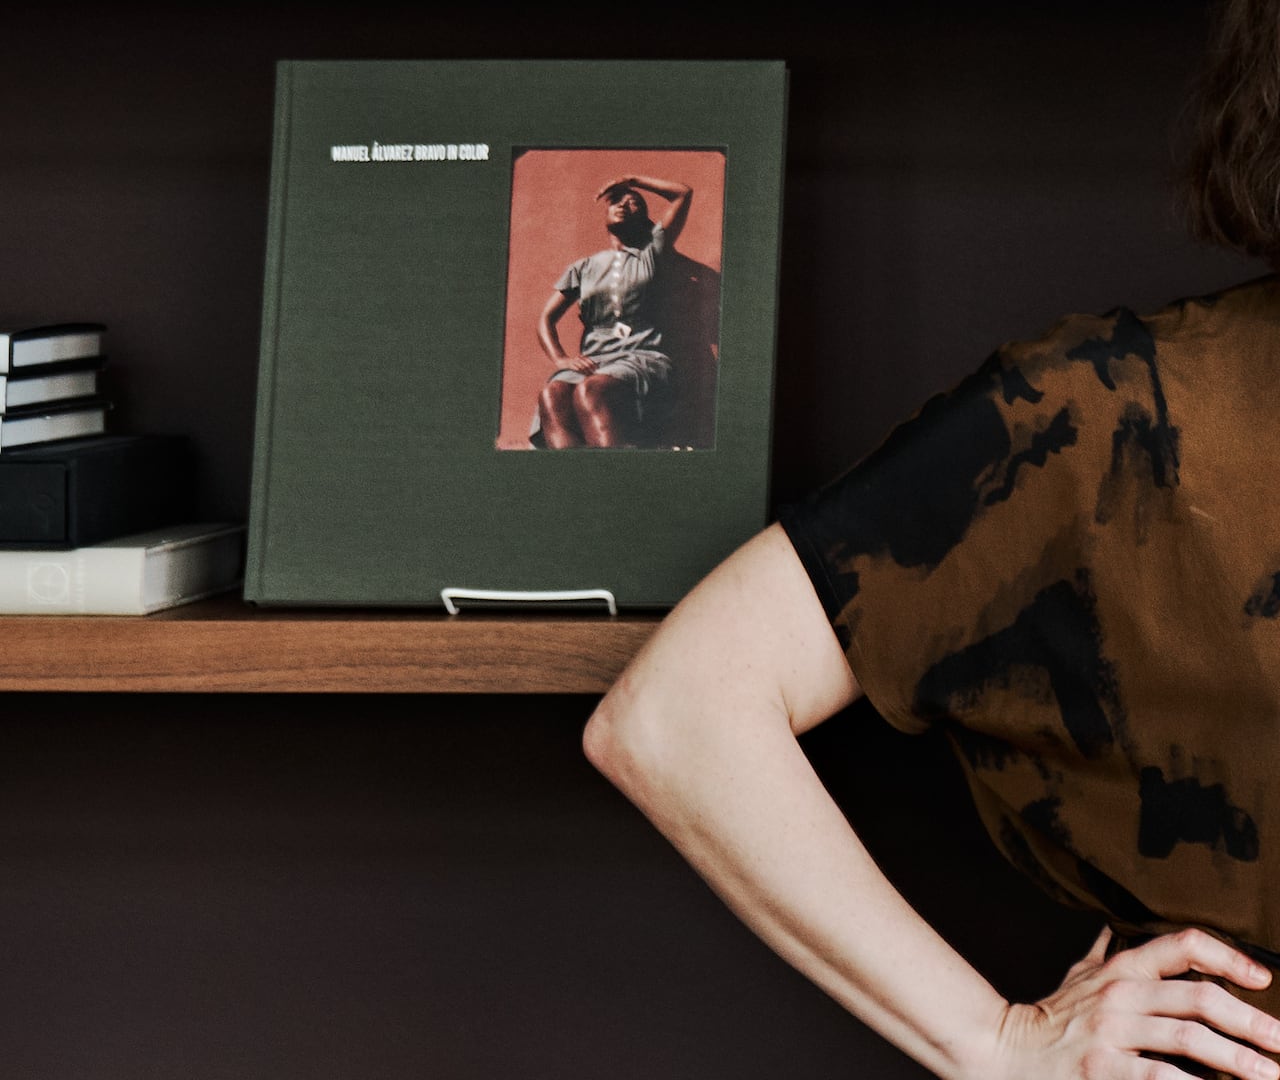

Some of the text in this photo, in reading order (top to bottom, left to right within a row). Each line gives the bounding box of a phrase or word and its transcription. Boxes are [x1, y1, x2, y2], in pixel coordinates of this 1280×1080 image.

[332, 145, 371, 162] MANUEL
[414, 144, 446, 161] BRAVO
[447, 144, 458, 161] IN
[458, 143, 489, 161] COLOR
